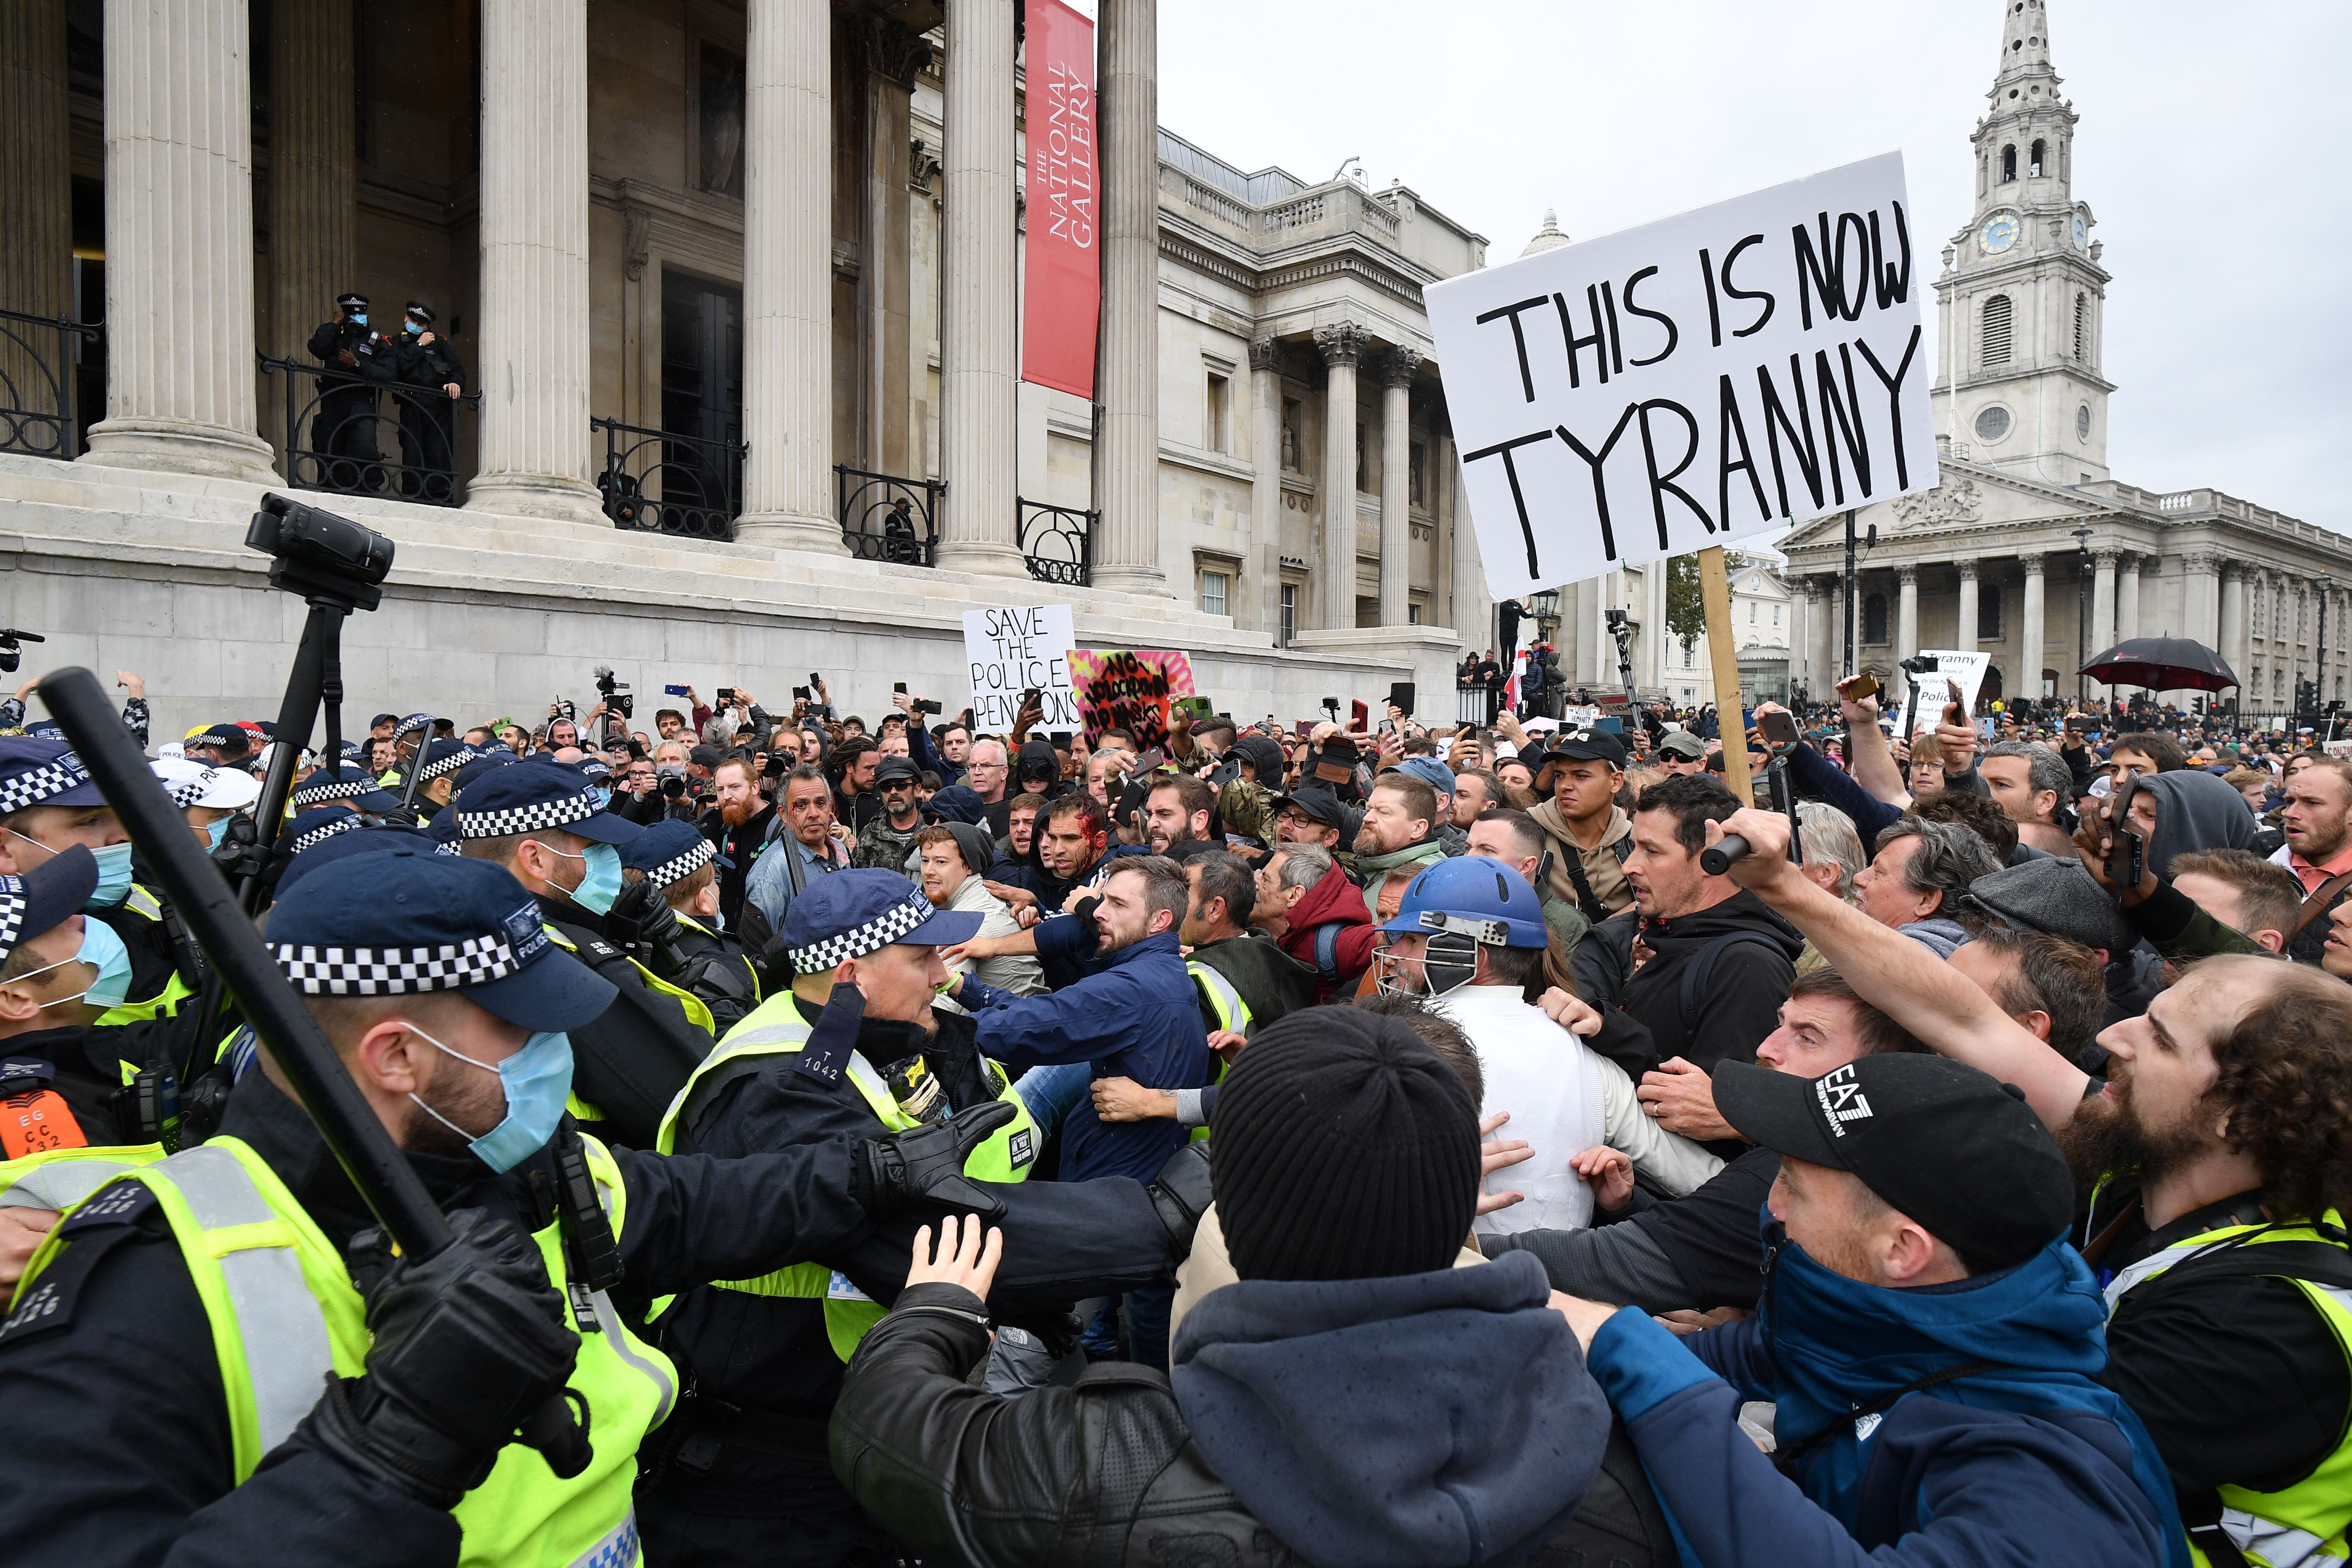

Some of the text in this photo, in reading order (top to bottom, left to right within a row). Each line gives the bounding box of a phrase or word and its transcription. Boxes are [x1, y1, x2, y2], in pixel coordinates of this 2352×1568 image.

[1048, 60, 1068, 242] NATIONAL
[1069, 66, 1092, 248] GALLERY
[1037, 149, 1046, 184] THE
[1476, 200, 1911, 403] THIS IS NOW
[1463, 325, 1922, 580] TYRANNY
[985, 606, 1048, 637] SAVE
[992, 636, 1037, 660] THE
[971, 658, 1069, 691] POLICE
[1921, 691, 1950, 702] Polic
[1111, 701, 1162, 727] MASKS
[1571, 715, 1591, 723] HUMANITY
[1575, 708, 1592, 716] WELFARE
[805, 1056, 838, 1081] 1042
[823, 1051, 832, 1062] T
[1824, 1064, 1874, 1122] EA7
[19, 1109, 44, 1127] EG
[25, 1124, 50, 1143] CC
[1005, 1329, 1020, 1339] NORTH
[1007, 1334, 1019, 1343] FACE
